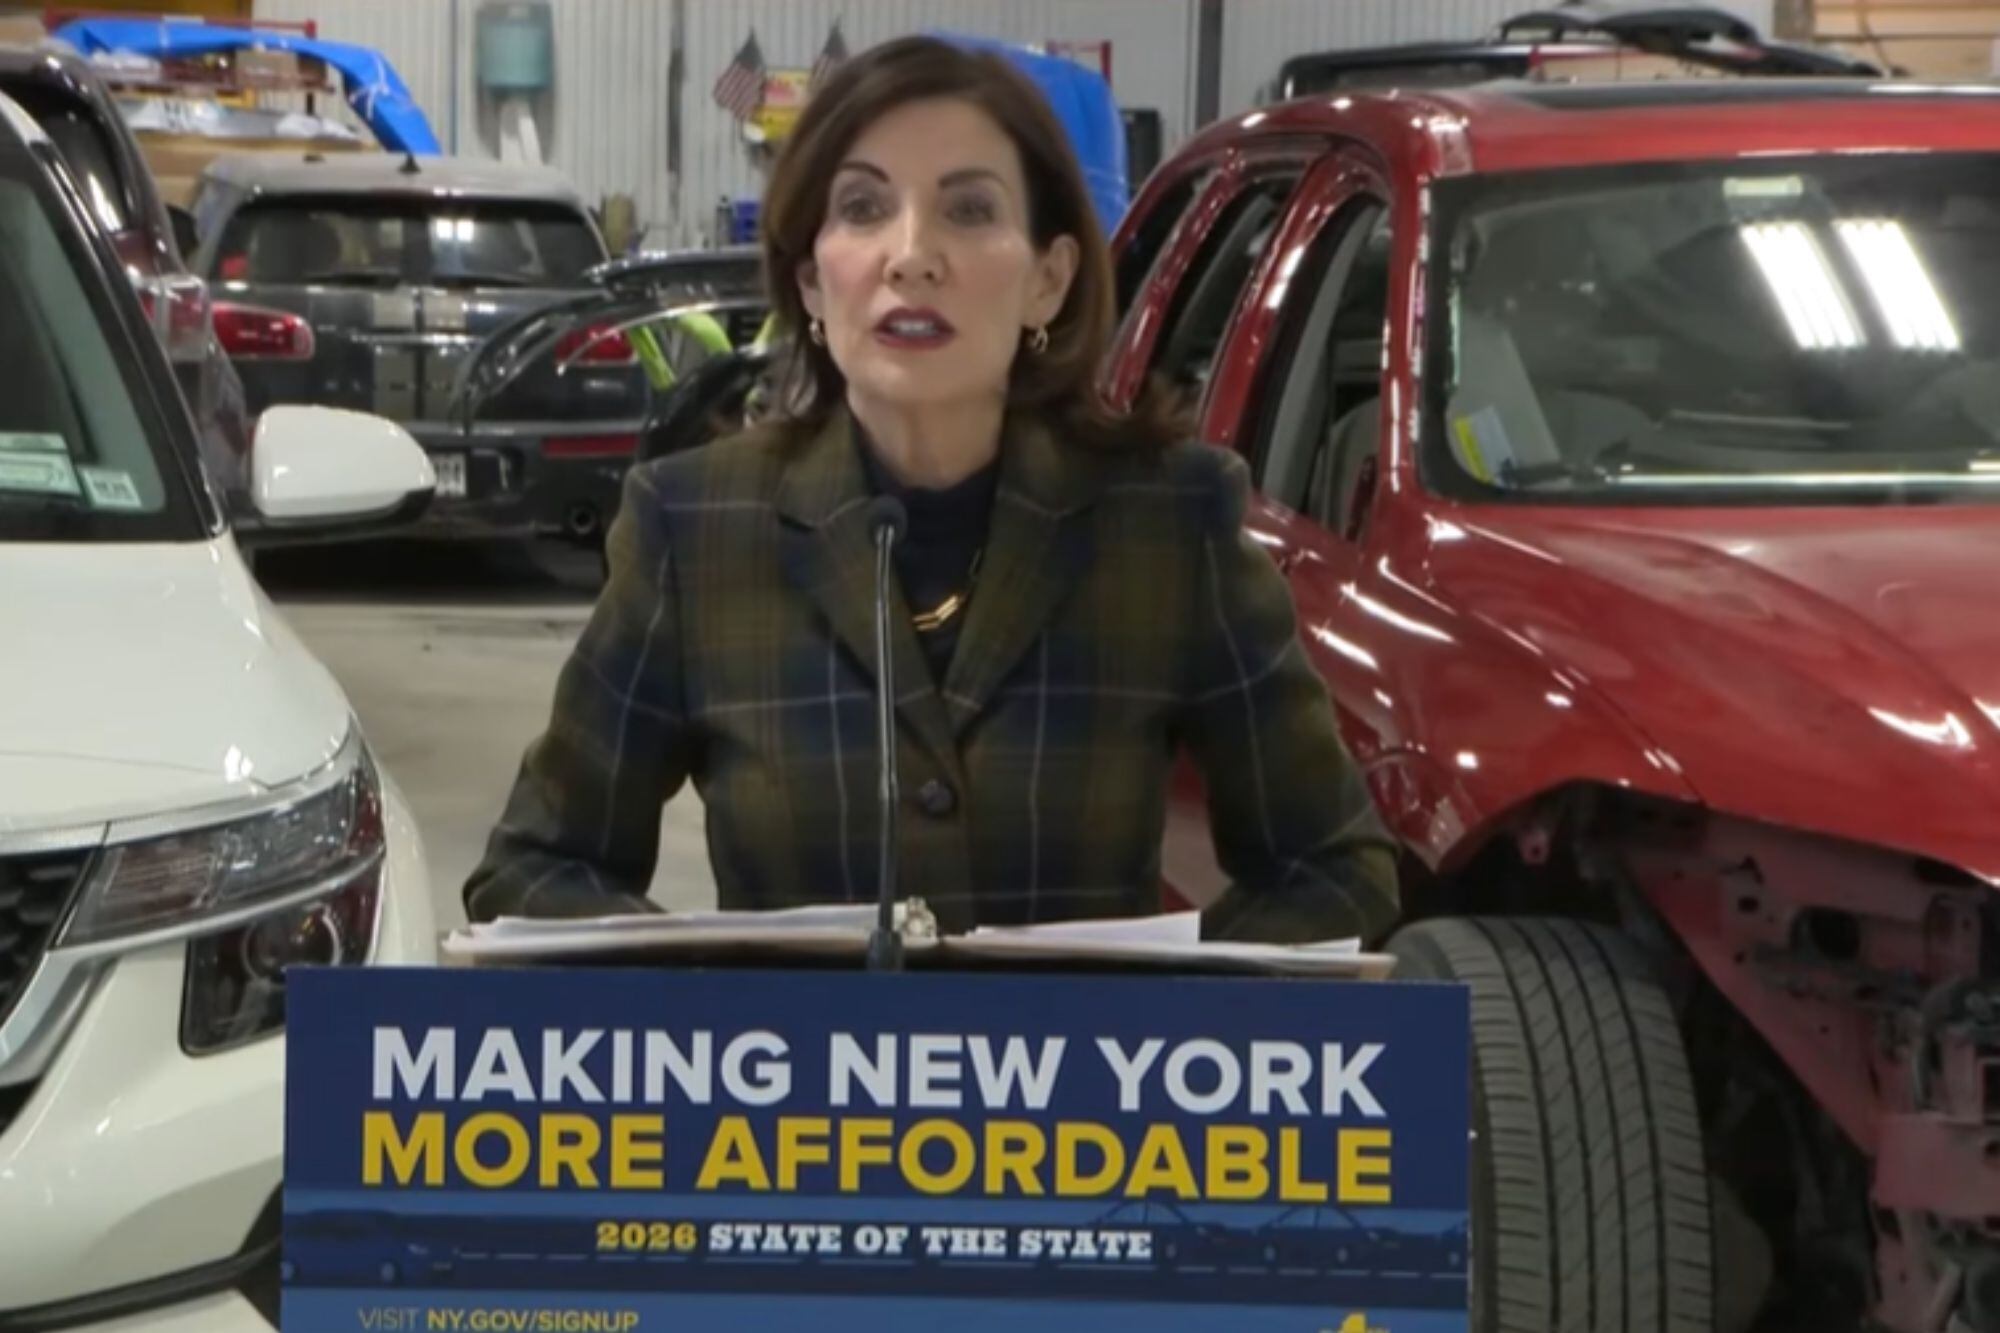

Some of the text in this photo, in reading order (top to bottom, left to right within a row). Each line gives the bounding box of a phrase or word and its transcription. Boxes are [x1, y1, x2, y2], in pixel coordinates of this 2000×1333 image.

[372, 1027, 1387, 1117] MAKING NEW YORK
[361, 1111, 1392, 1203] MORE AFFORDABLE
[596, 1221, 1153, 1259] 2026 STATE OF THE STATE
[358, 1307, 640, 1333] VISIT NY.GOV/SIGNUP
